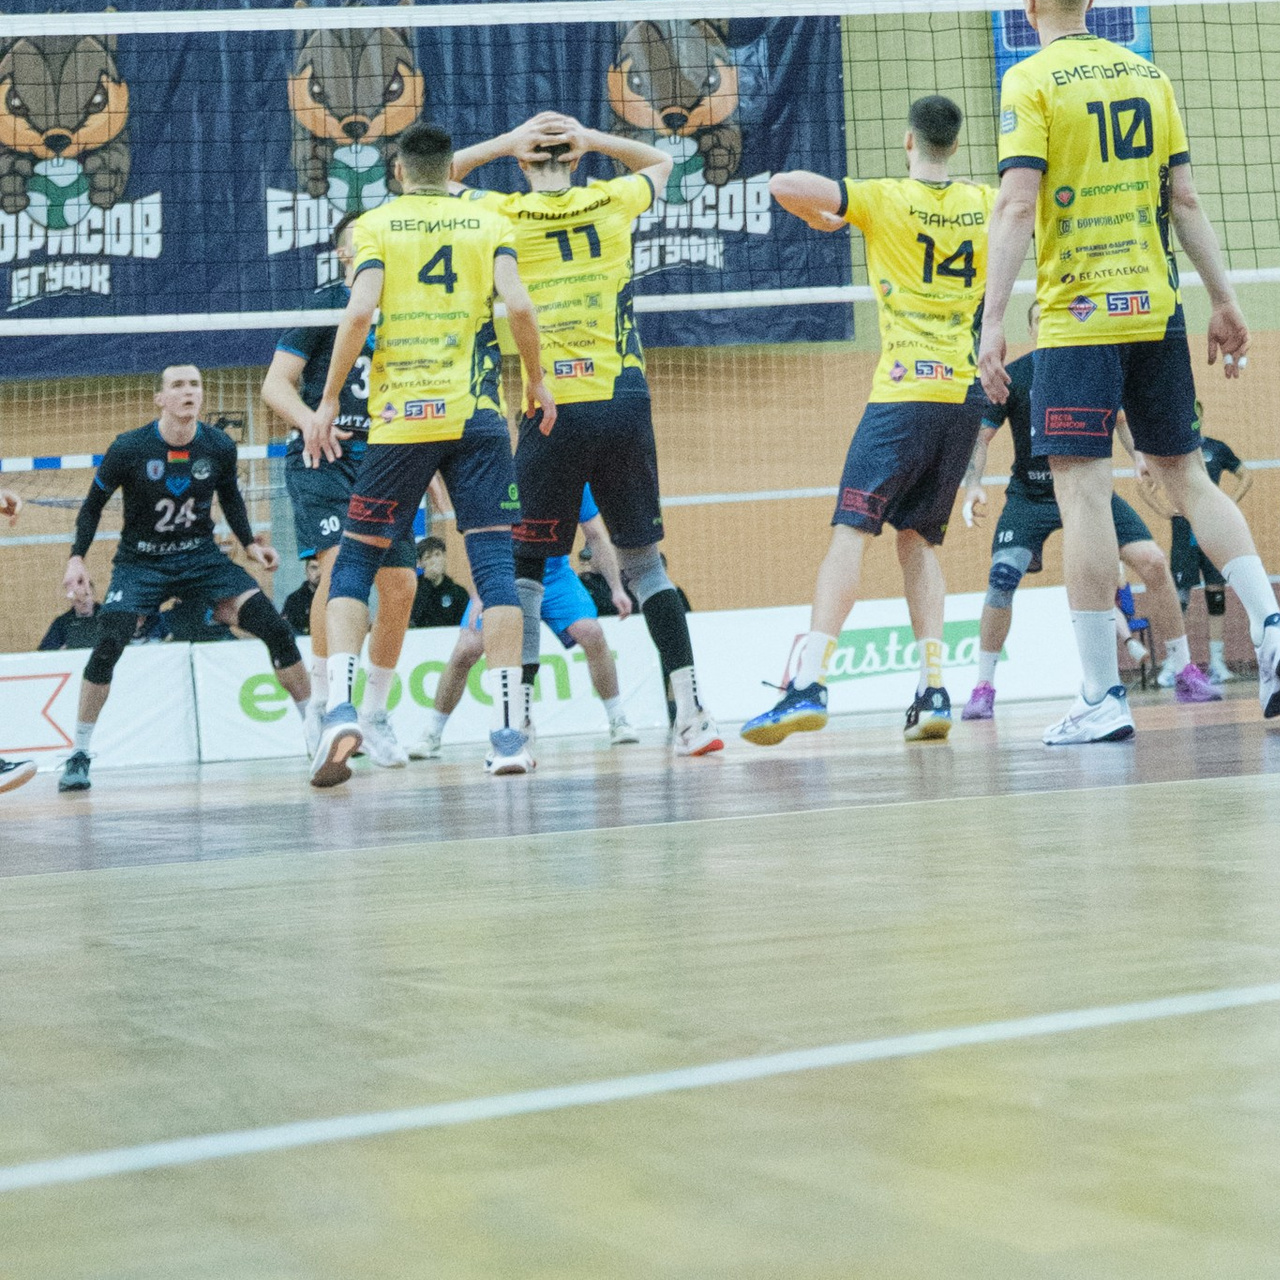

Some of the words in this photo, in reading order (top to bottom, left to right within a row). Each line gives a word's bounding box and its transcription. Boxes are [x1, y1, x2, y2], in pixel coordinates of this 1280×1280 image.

[1051, 62, 1161, 86] ЕМЕЛЬЯНОВ
[1086, 97, 1154, 163] 10
[632, 171, 771, 235] РИСОВ
[0, 192, 162, 263] ОРИСОВ
[390, 218, 480, 234] ВЕЛИЧКО
[545, 223, 601, 262] 11
[418, 245, 458, 294] 4
[916, 232, 976, 288] 14
[154, 497, 198, 533] 24
[320, 515, 340, 536] 30
[999, 530, 1014, 543] 18
